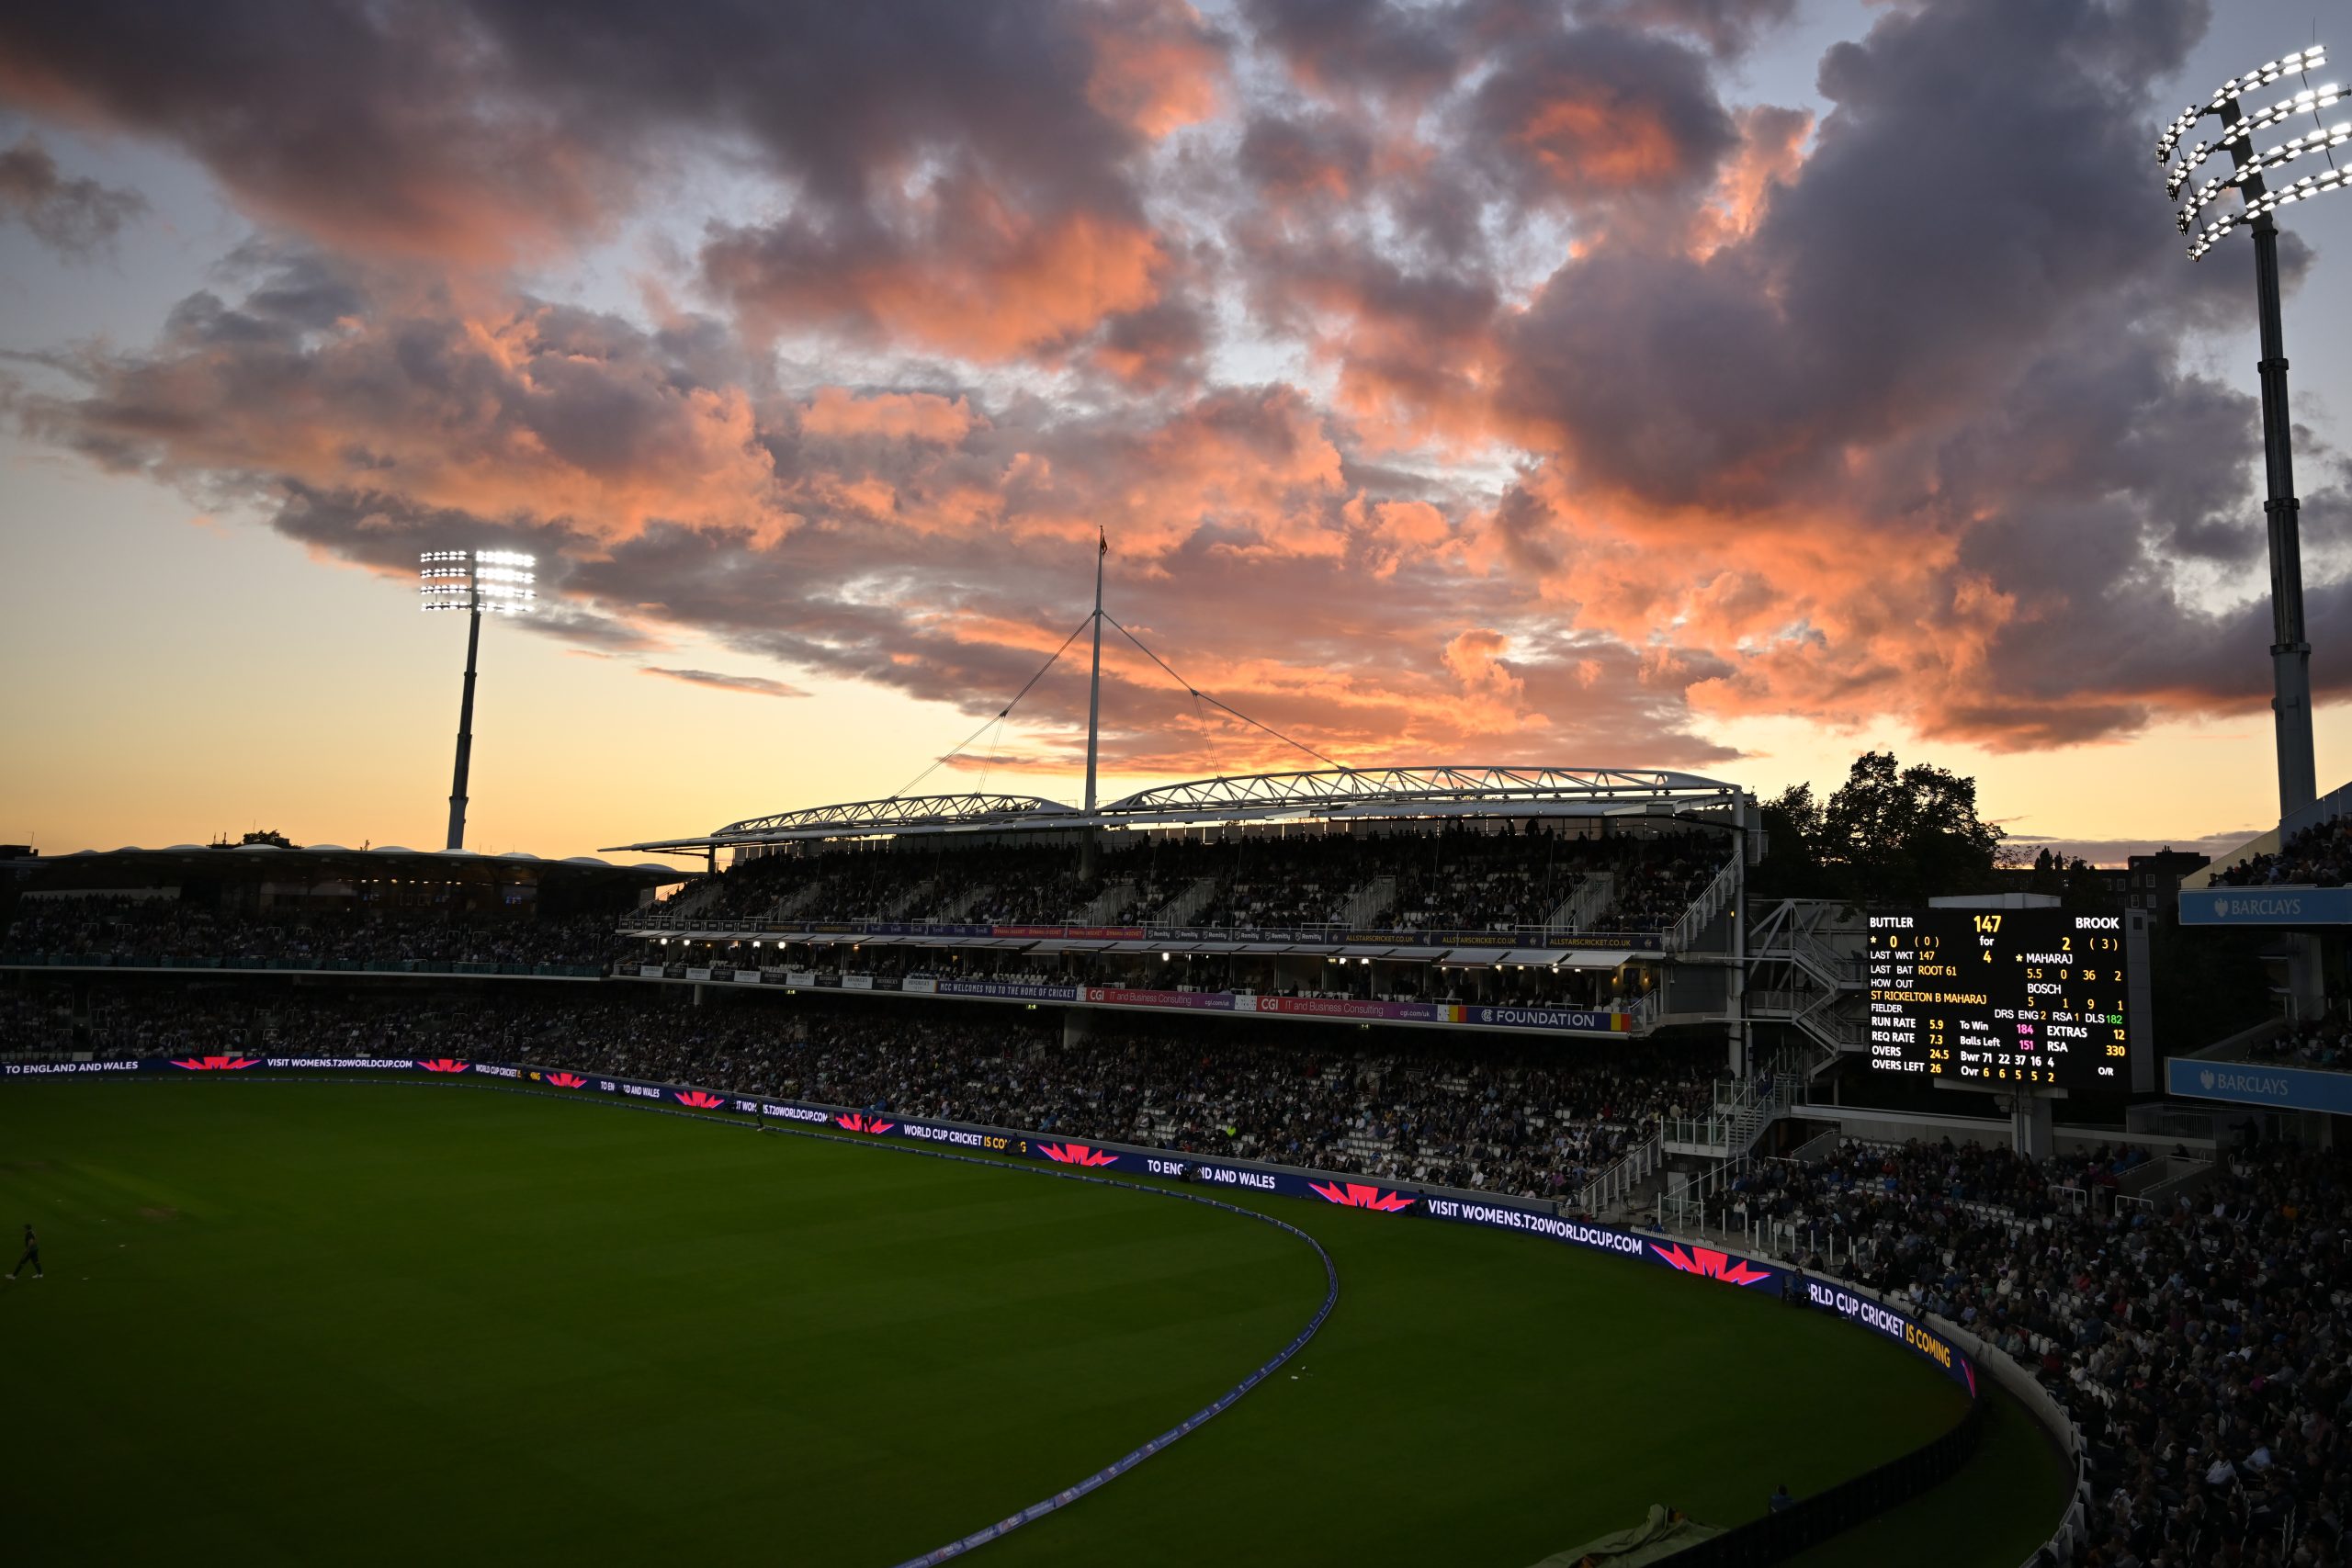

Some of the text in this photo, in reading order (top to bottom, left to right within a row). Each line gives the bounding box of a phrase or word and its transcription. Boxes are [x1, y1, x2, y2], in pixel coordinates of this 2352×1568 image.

[2232, 899, 2301, 915] BARCLAYS
[1870, 917, 1914, 928] BUTTLER
[1973, 915, 2002, 932] 147
[2075, 917, 2120, 930] BROOK
[1346, 934, 1414, 942] ALLSTARSCRICKET.CO.UK
[1442, 936, 1516, 944] ALLSTARSCRICKET.CO.UK
[1549, 938, 1631, 947] ALLSTARSCRICKET.CO.UK
[1889, 935, 1897, 948] 0
[1979, 935, 1995, 946] for
[2062, 936, 2071, 951] 2
[1870, 951, 1935, 961] LAST WKT 147
[1983, 950, 1992, 964] 4
[2026, 953, 2074, 964] MAHARAJ
[1870, 965, 1957, 976] LAST BAT ROOT 61
[2027, 968, 2121, 981] 5.5 0 36 2
[940, 982, 1075, 998] MCC WELCOMES YOU TO THE HOME OF CRICKET
[1871, 978, 1914, 988] HOW OUT
[2027, 983, 2062, 995] BOSCH
[1090, 989, 1104, 1000] CGI
[1110, 991, 1192, 1007] IT and Business Consulting
[1871, 990, 1987, 1005] ST RICKELTON B MAHARAJ
[1204, 999, 1230, 1008] cgi.com/uk
[1261, 998, 1279, 1010] CGI
[1285, 999, 1384, 1016] IT and Business Consulting
[1871, 1003, 1903, 1013] FIELDER
[2028, 996, 2123, 1010] 5 1 9 1
[1399, 1010, 1430, 1019] cgi.com/uk
[1497, 1010, 1595, 1027] FOUNDATION
[1995, 1009, 2123, 1024] DRS ENG 2 RSA 1 DLS 182
[1871, 1016, 1944, 1030] RUN RATE 5.9
[1960, 1021, 2034, 1034] To Win 184
[1871, 1031, 1943, 1044] REQ RATE 7.3
[2047, 1025, 2125, 1041] EXTRAS 12
[1960, 1036, 2034, 1051] Balls Left 151
[2047, 1041, 2126, 1057] RSA 330
[1871, 1045, 1950, 1060] OVERS 24.5
[1960, 1051, 2054, 1068] Bwr 71 22 37 16 4
[6, 1061, 139, 1074] TO ENGLAND AND WALES
[266, 1058, 413, 1068] VISIT WOMENS.T20WORLDCUP.COM
[475, 1063, 491, 1074] WORLD
[490, 1066, 500, 1075] CUP
[499, 1067, 517, 1077] CRICKET
[1871, 1059, 1942, 1074] OVERS LEFT 26
[1961, 1066, 2054, 1082] Ovr 6 6 5 5 2
[2098, 1066, 2114, 1077] O/R
[600, 1080, 661, 1099] TO ENND AND WALES
[2218, 1073, 2289, 1096] BARCLAYS
[742, 1101, 829, 1122] WOMS.T20WORLDCUP.COM
[903, 1123, 932, 1138] WORLD
[932, 1128, 949, 1141] CUP
[949, 1131, 983, 1146] CRICKET
[983, 1136, 992, 1147] IS
[1148, 1159, 1275, 1190] TO ENGND AND WALES
[1427, 1199, 1643, 1256] VISIT WOMENS.T20WORLDCUP.COM
[1808, 1283, 1951, 1368] RLD CUP CRICKET IS COMING
